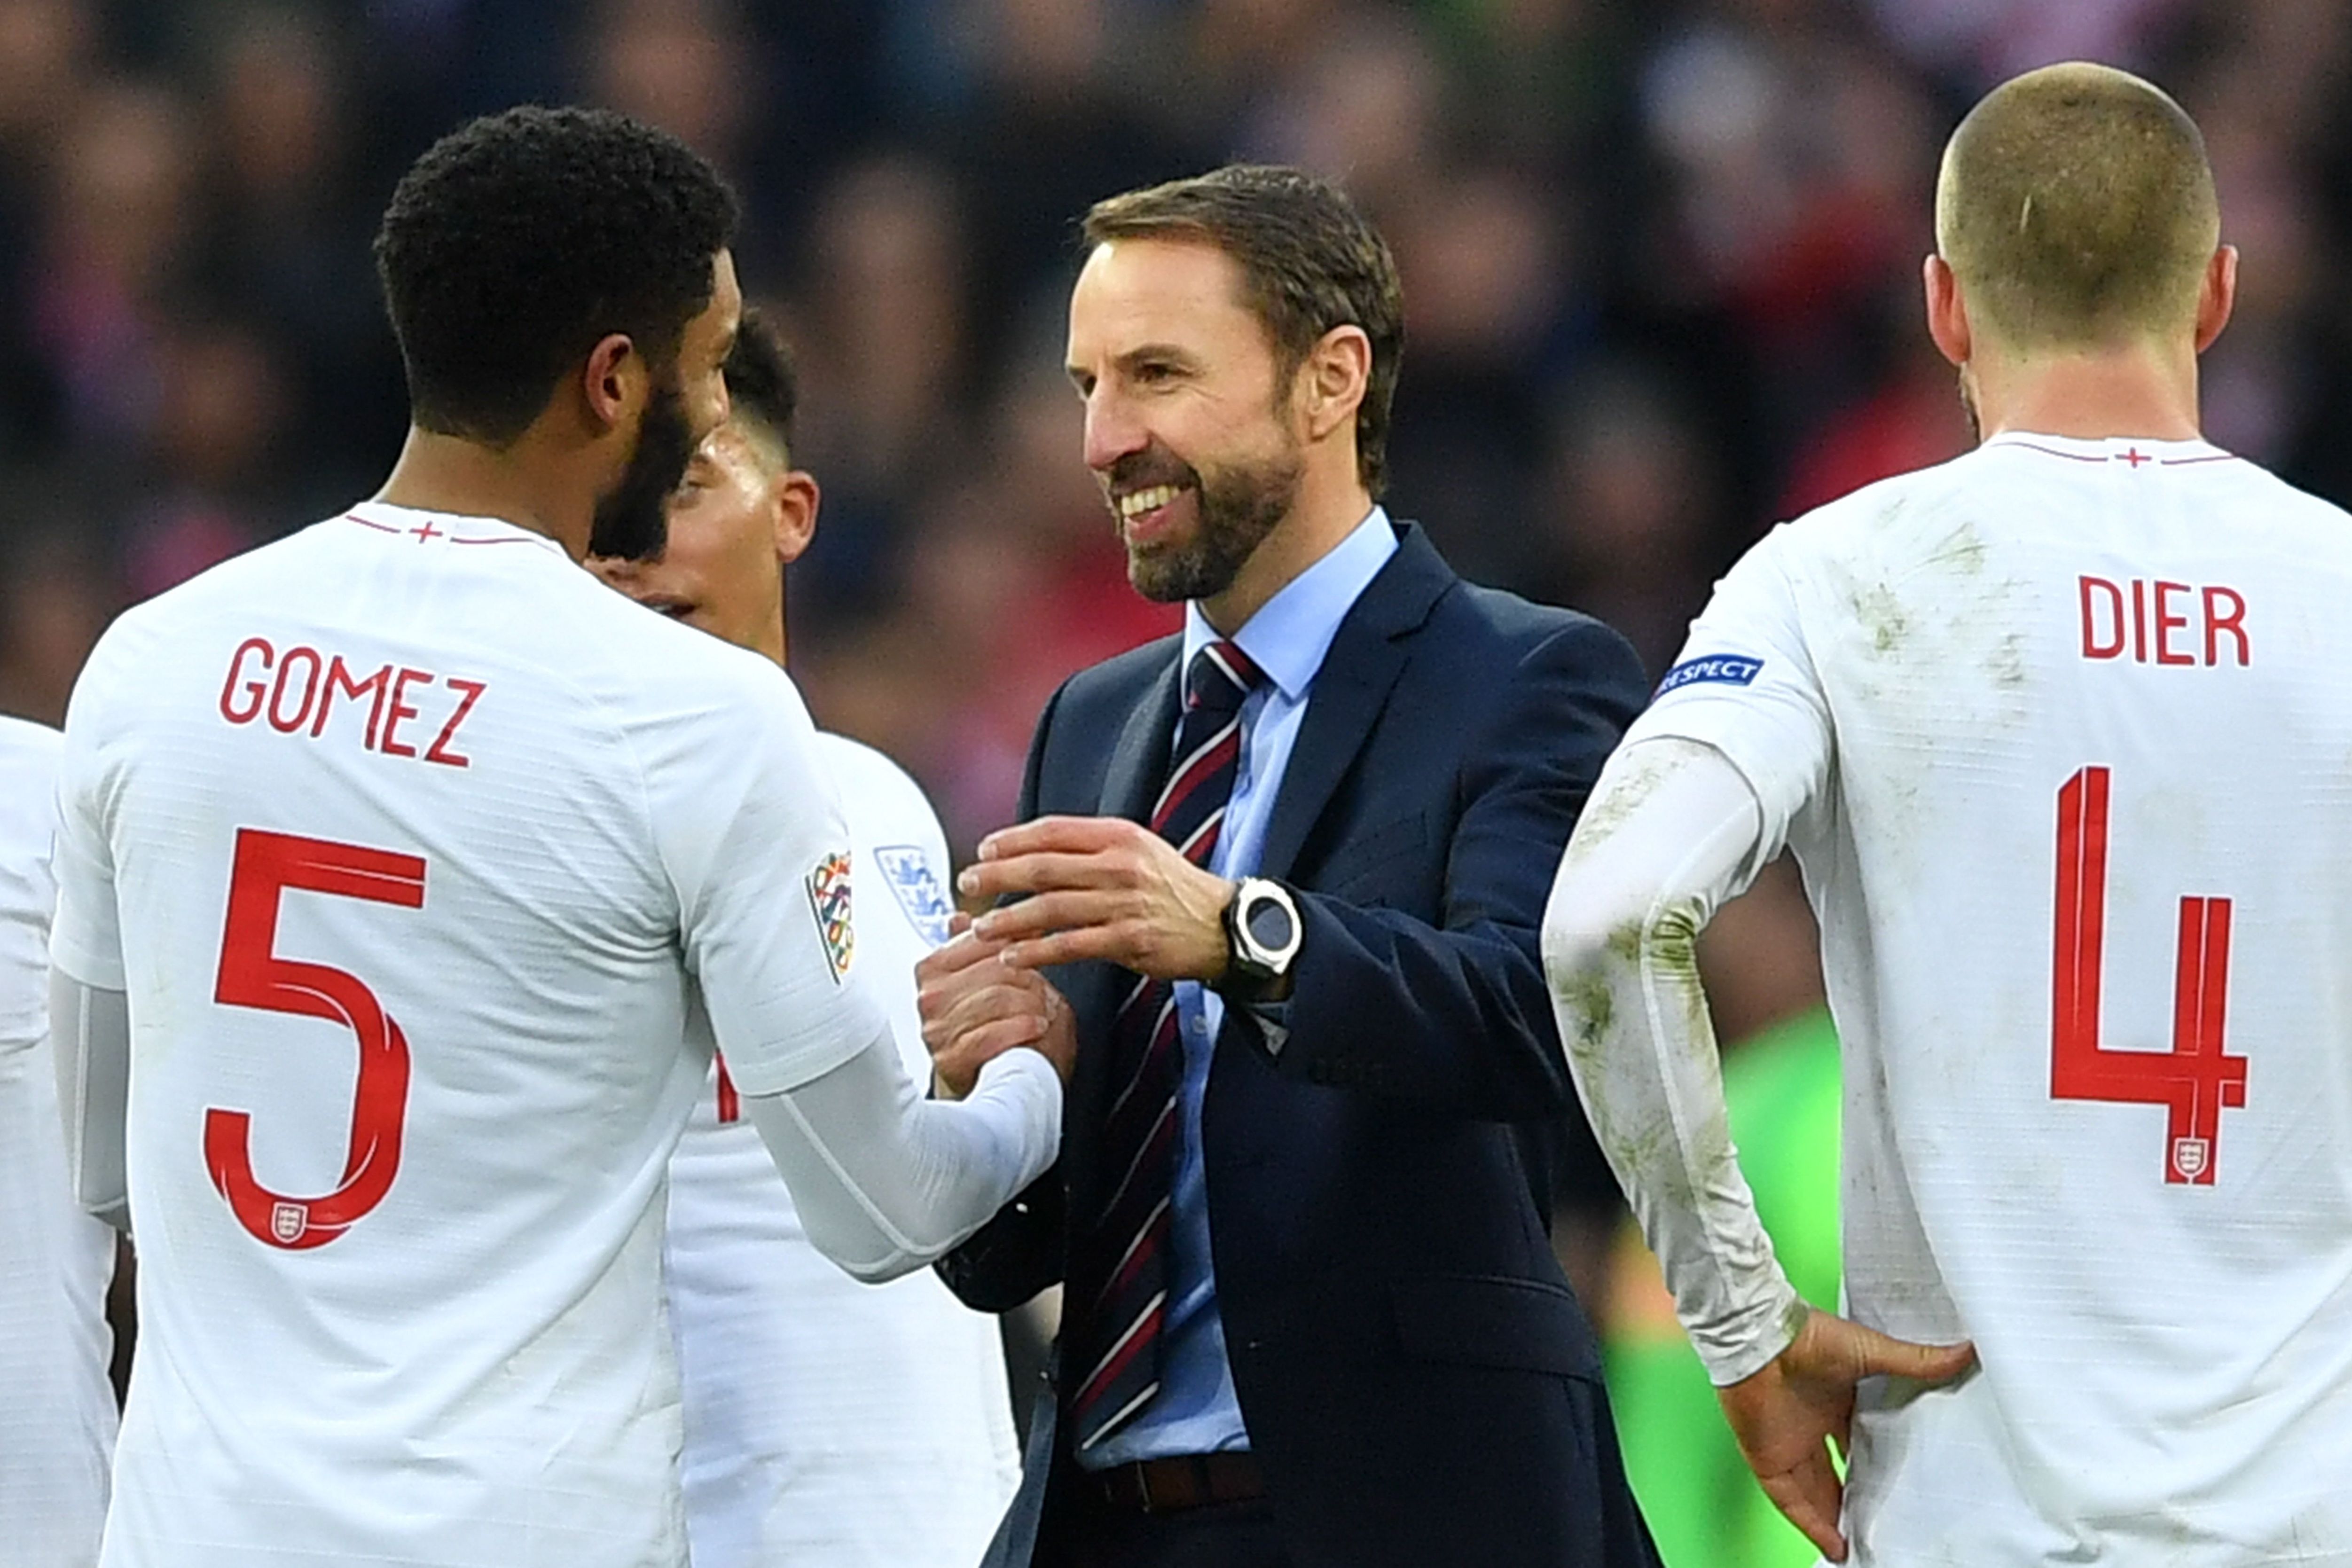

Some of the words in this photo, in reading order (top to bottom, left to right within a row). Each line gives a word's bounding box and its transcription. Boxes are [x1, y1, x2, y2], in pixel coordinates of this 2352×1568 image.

[220, 638, 486, 767] GOMEZ
[2080, 576, 2250, 666] DIER
[204, 828, 426, 1250] 5
[2051, 766, 2248, 1185] 4
